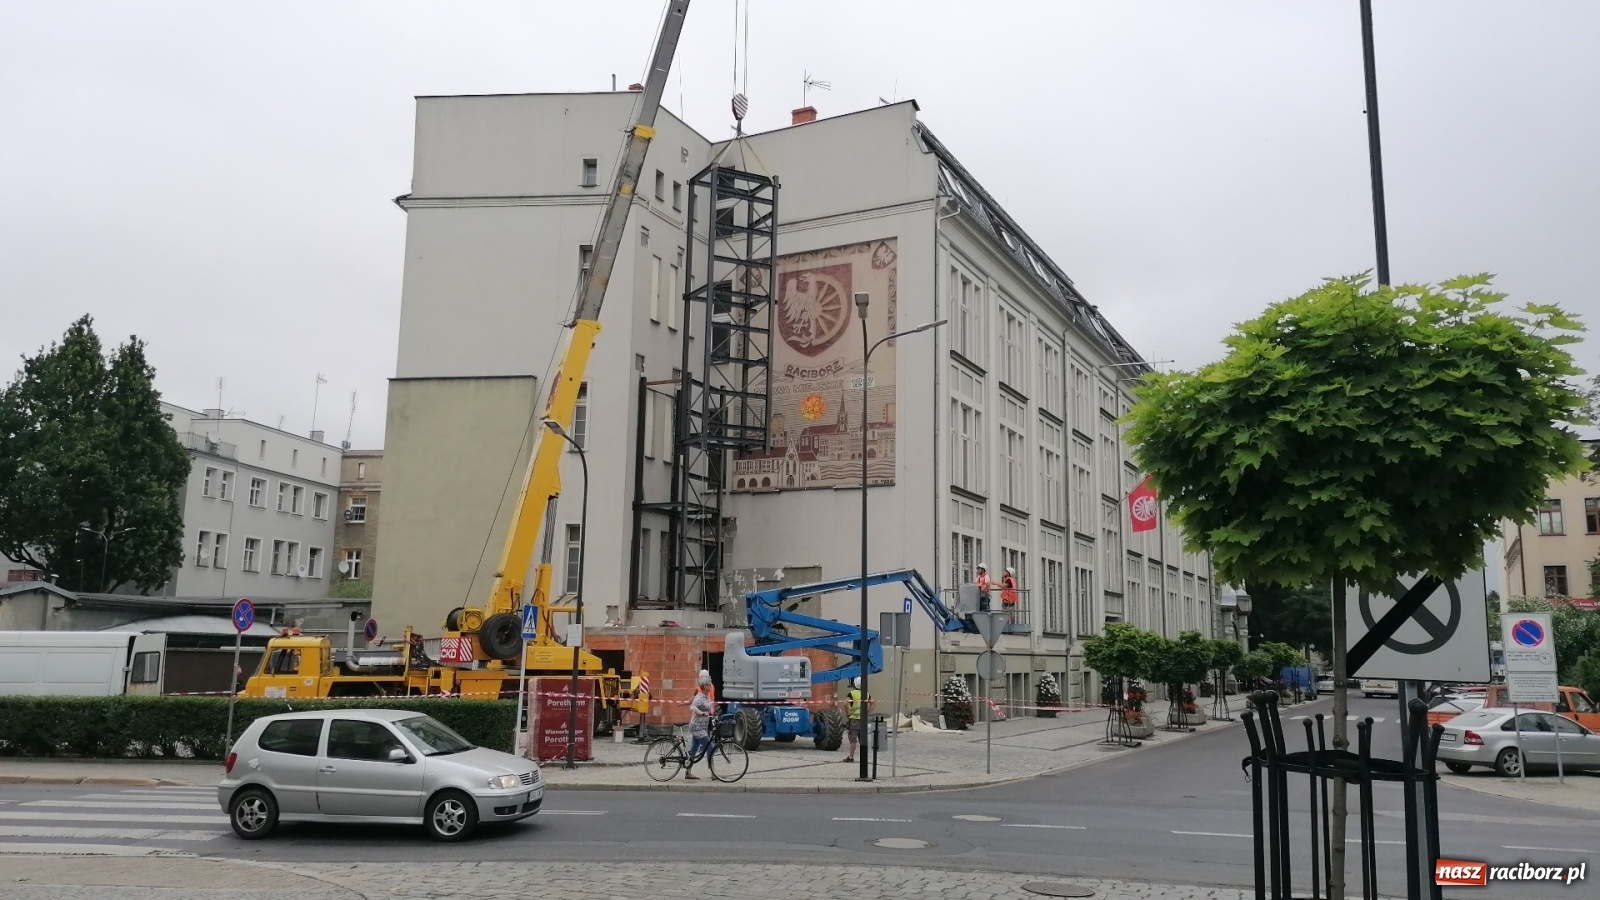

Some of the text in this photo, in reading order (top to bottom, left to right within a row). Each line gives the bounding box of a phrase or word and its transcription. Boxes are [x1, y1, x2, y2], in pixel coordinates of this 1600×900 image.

[851, 376, 874, 388] 127
[547, 699, 586, 707] Porothrm
[545, 736, 585, 744] Porothrm
